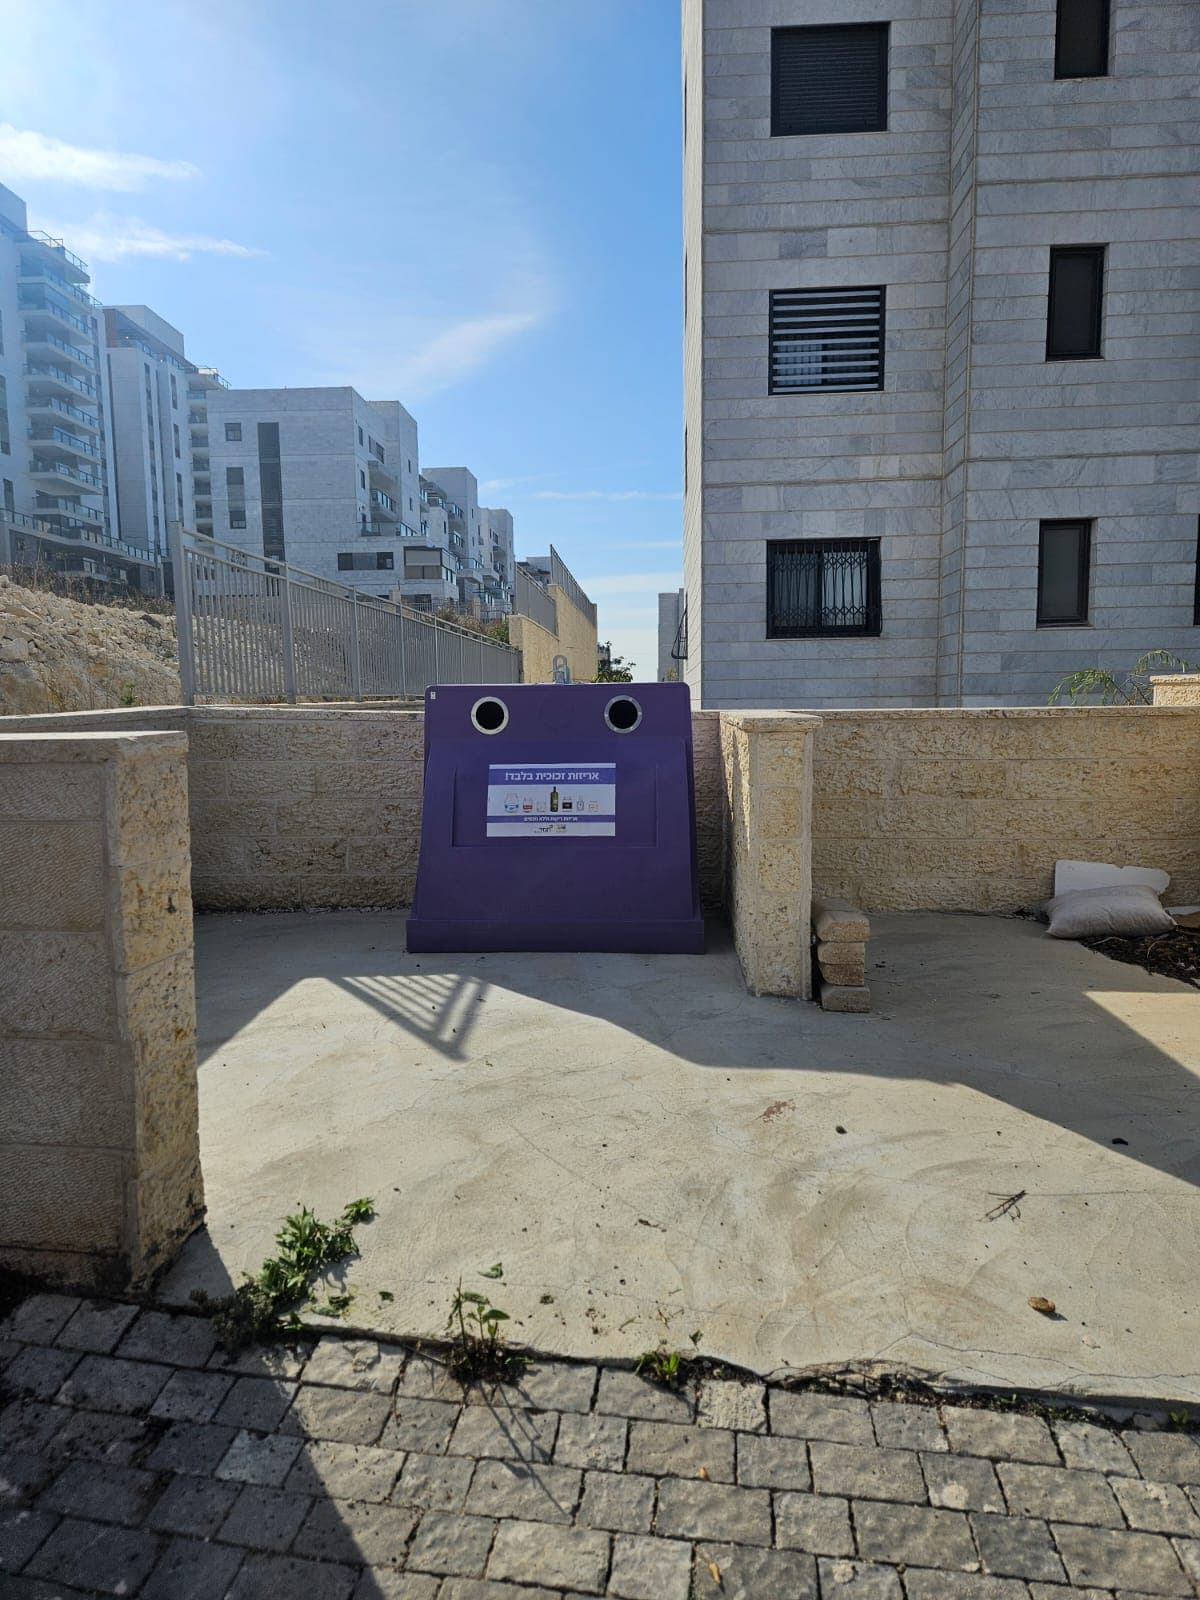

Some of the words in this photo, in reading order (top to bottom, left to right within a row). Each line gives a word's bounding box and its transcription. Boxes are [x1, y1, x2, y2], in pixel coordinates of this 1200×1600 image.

[505, 771, 533, 781] בלבד!
[535, 772, 565, 780] זכוכית
[568, 772, 600, 780] אריזות
